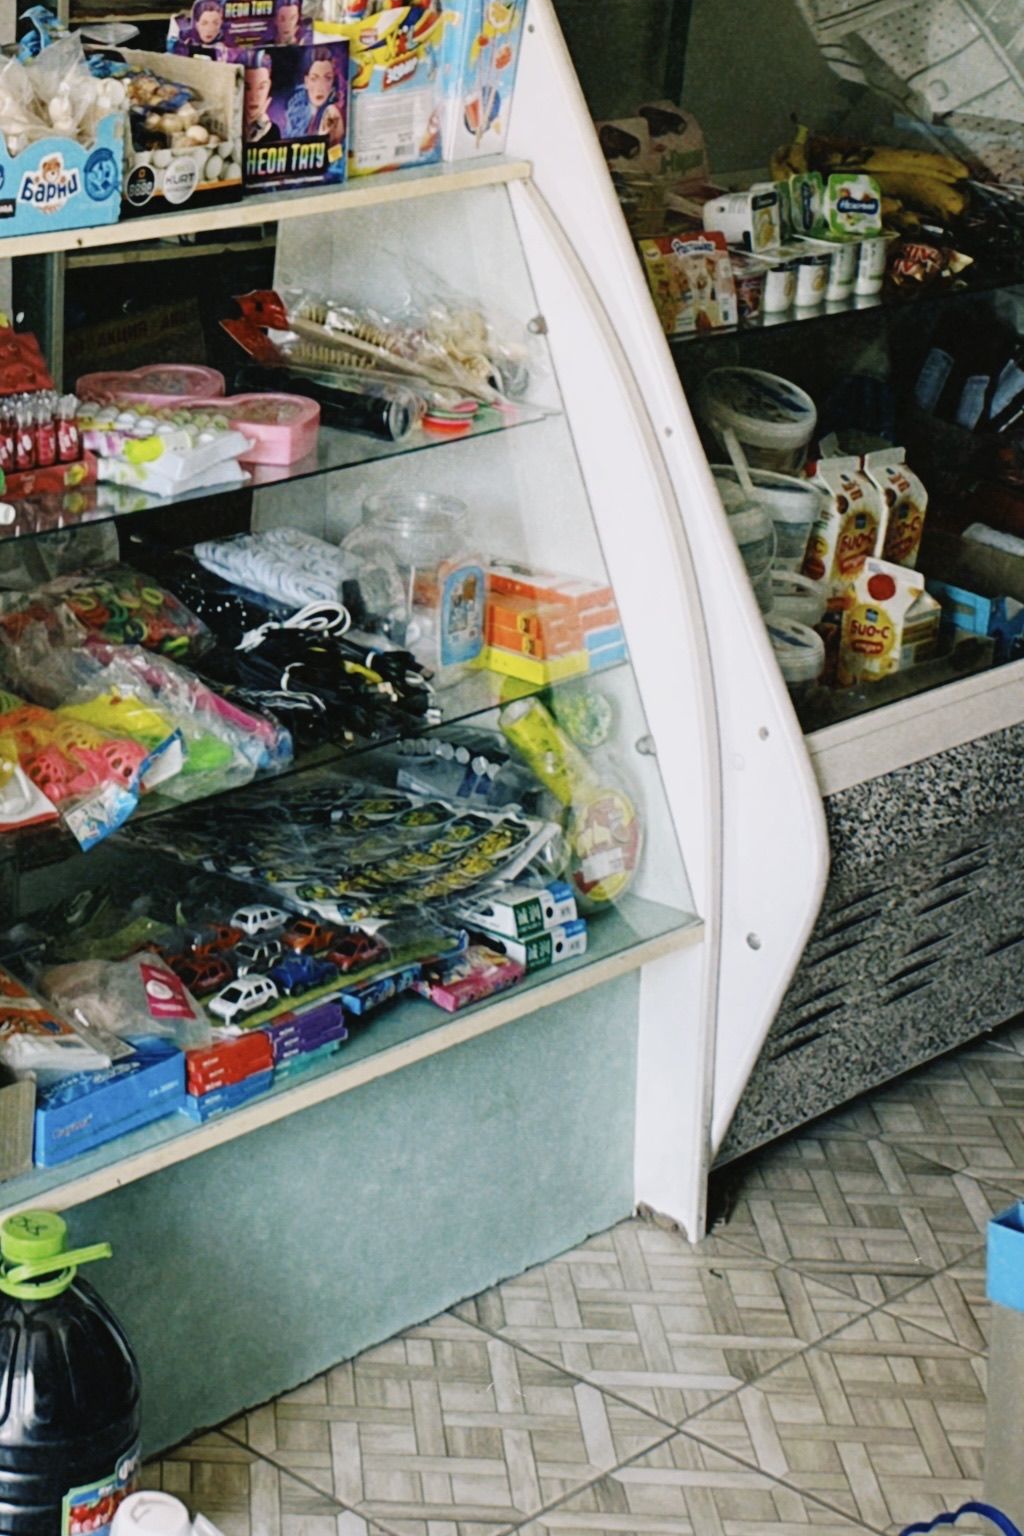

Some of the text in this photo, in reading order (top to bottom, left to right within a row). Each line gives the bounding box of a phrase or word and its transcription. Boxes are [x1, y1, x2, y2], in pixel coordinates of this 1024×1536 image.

[247, 142, 326, 176] НЕОН ТАТУ
[21, 173, 79, 202] Барни
